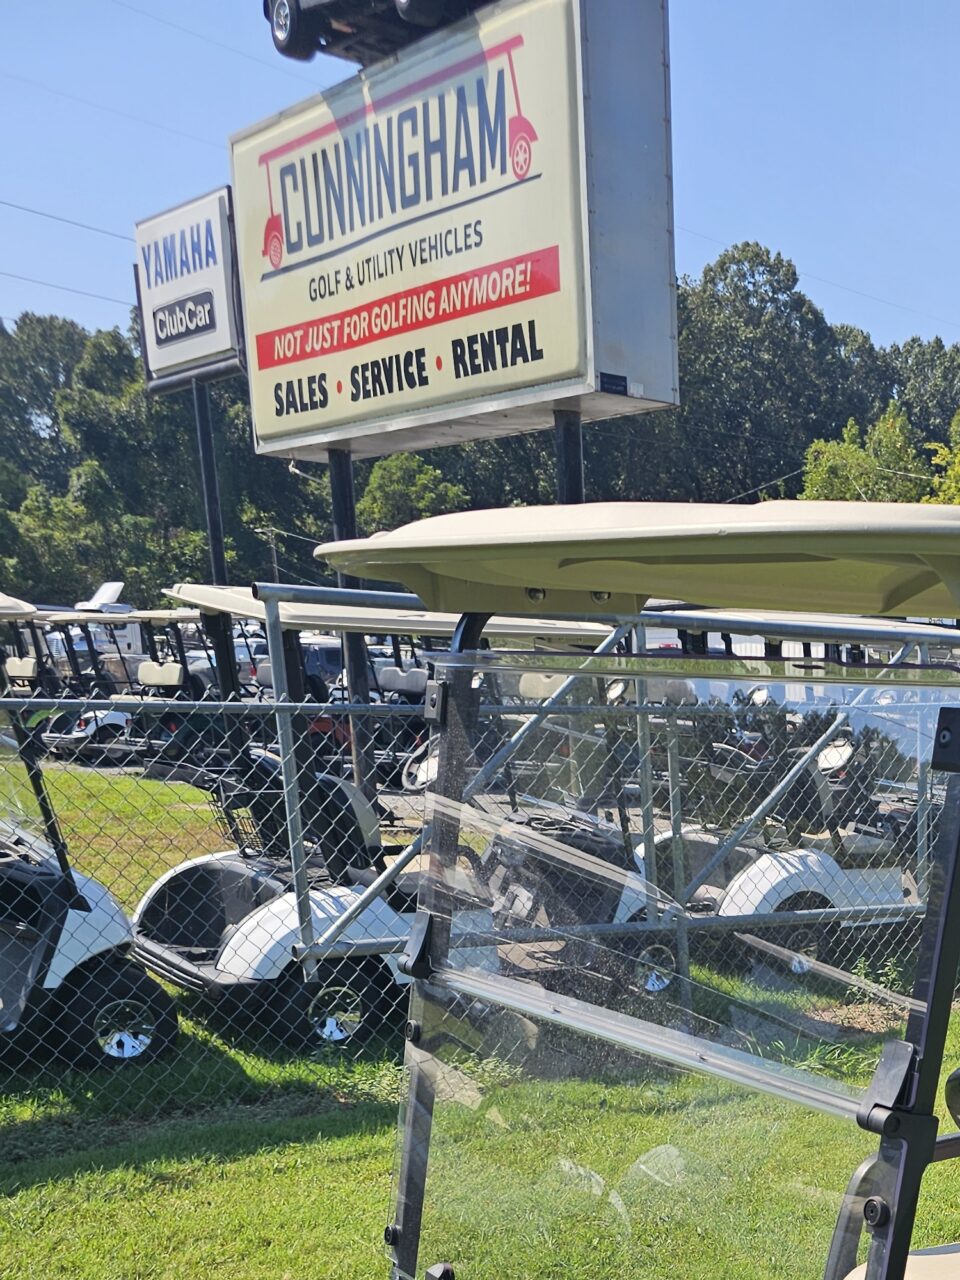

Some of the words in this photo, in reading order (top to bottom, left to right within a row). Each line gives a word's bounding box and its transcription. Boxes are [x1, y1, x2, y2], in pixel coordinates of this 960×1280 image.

[279, 68, 507, 255] CUNNINGHAM
[141, 219, 218, 290] YAMAHA
[308, 269, 341, 302] GOLF
[345, 268, 355, 291] &
[356, 245, 406, 286] UTILITY
[408, 219, 484, 268] VEHICLES
[273, 329, 304, 361] NOT
[305, 319, 342, 353] JUST
[343, 311, 369, 344] FOR
[371, 290, 436, 335] GOLFING
[438, 261, 532, 314] ANYMORE!
[274, 372, 328, 417] SALES
[350, 347, 429, 402] SERVICE
[451, 319, 544, 379] RENTAL
